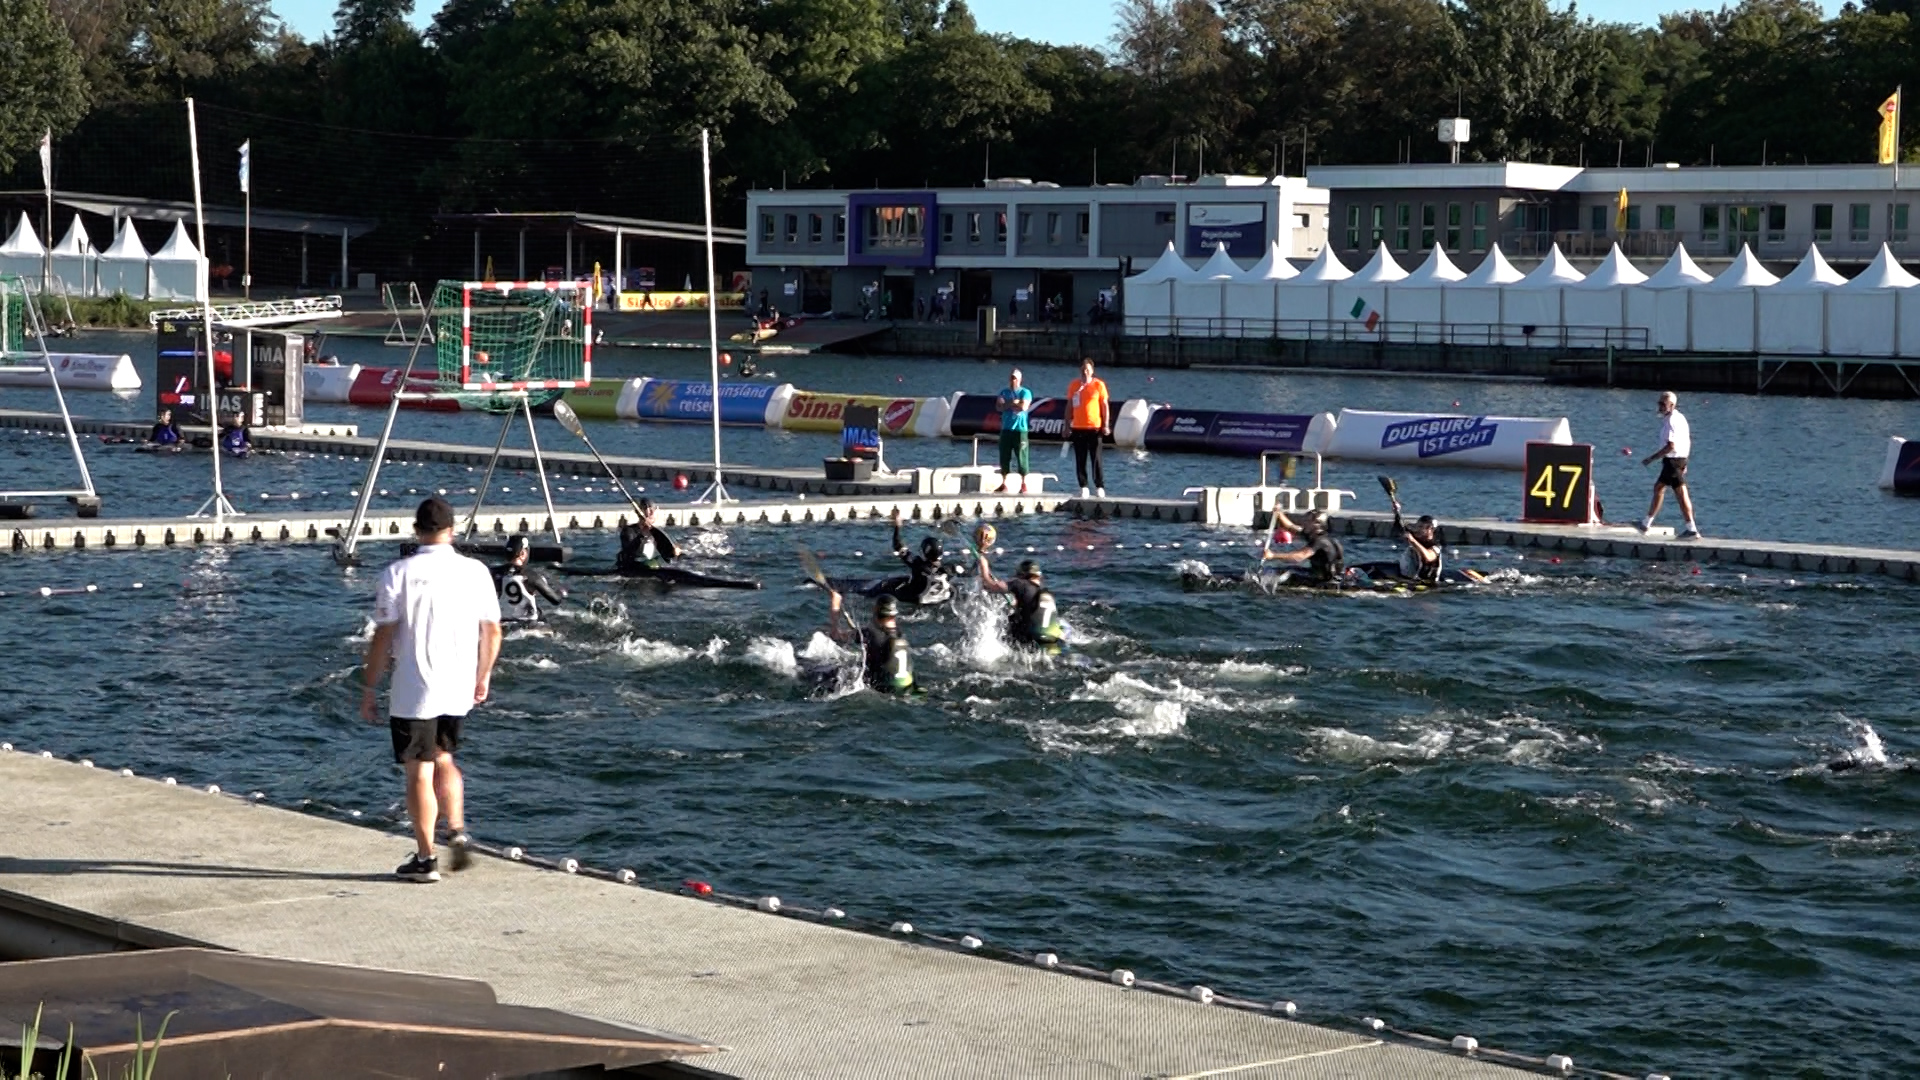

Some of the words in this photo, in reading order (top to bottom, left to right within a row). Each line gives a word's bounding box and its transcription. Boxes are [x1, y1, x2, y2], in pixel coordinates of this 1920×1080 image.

[680, 398, 714, 413] reise
[1386, 418, 1477, 443] DUISBURG
[1422, 438, 1447, 453] IST
[1449, 429, 1492, 448] ECHT
[1530, 465, 1582, 508] 47
[505, 581, 523, 605] 9
[894, 649, 908, 679] 1
